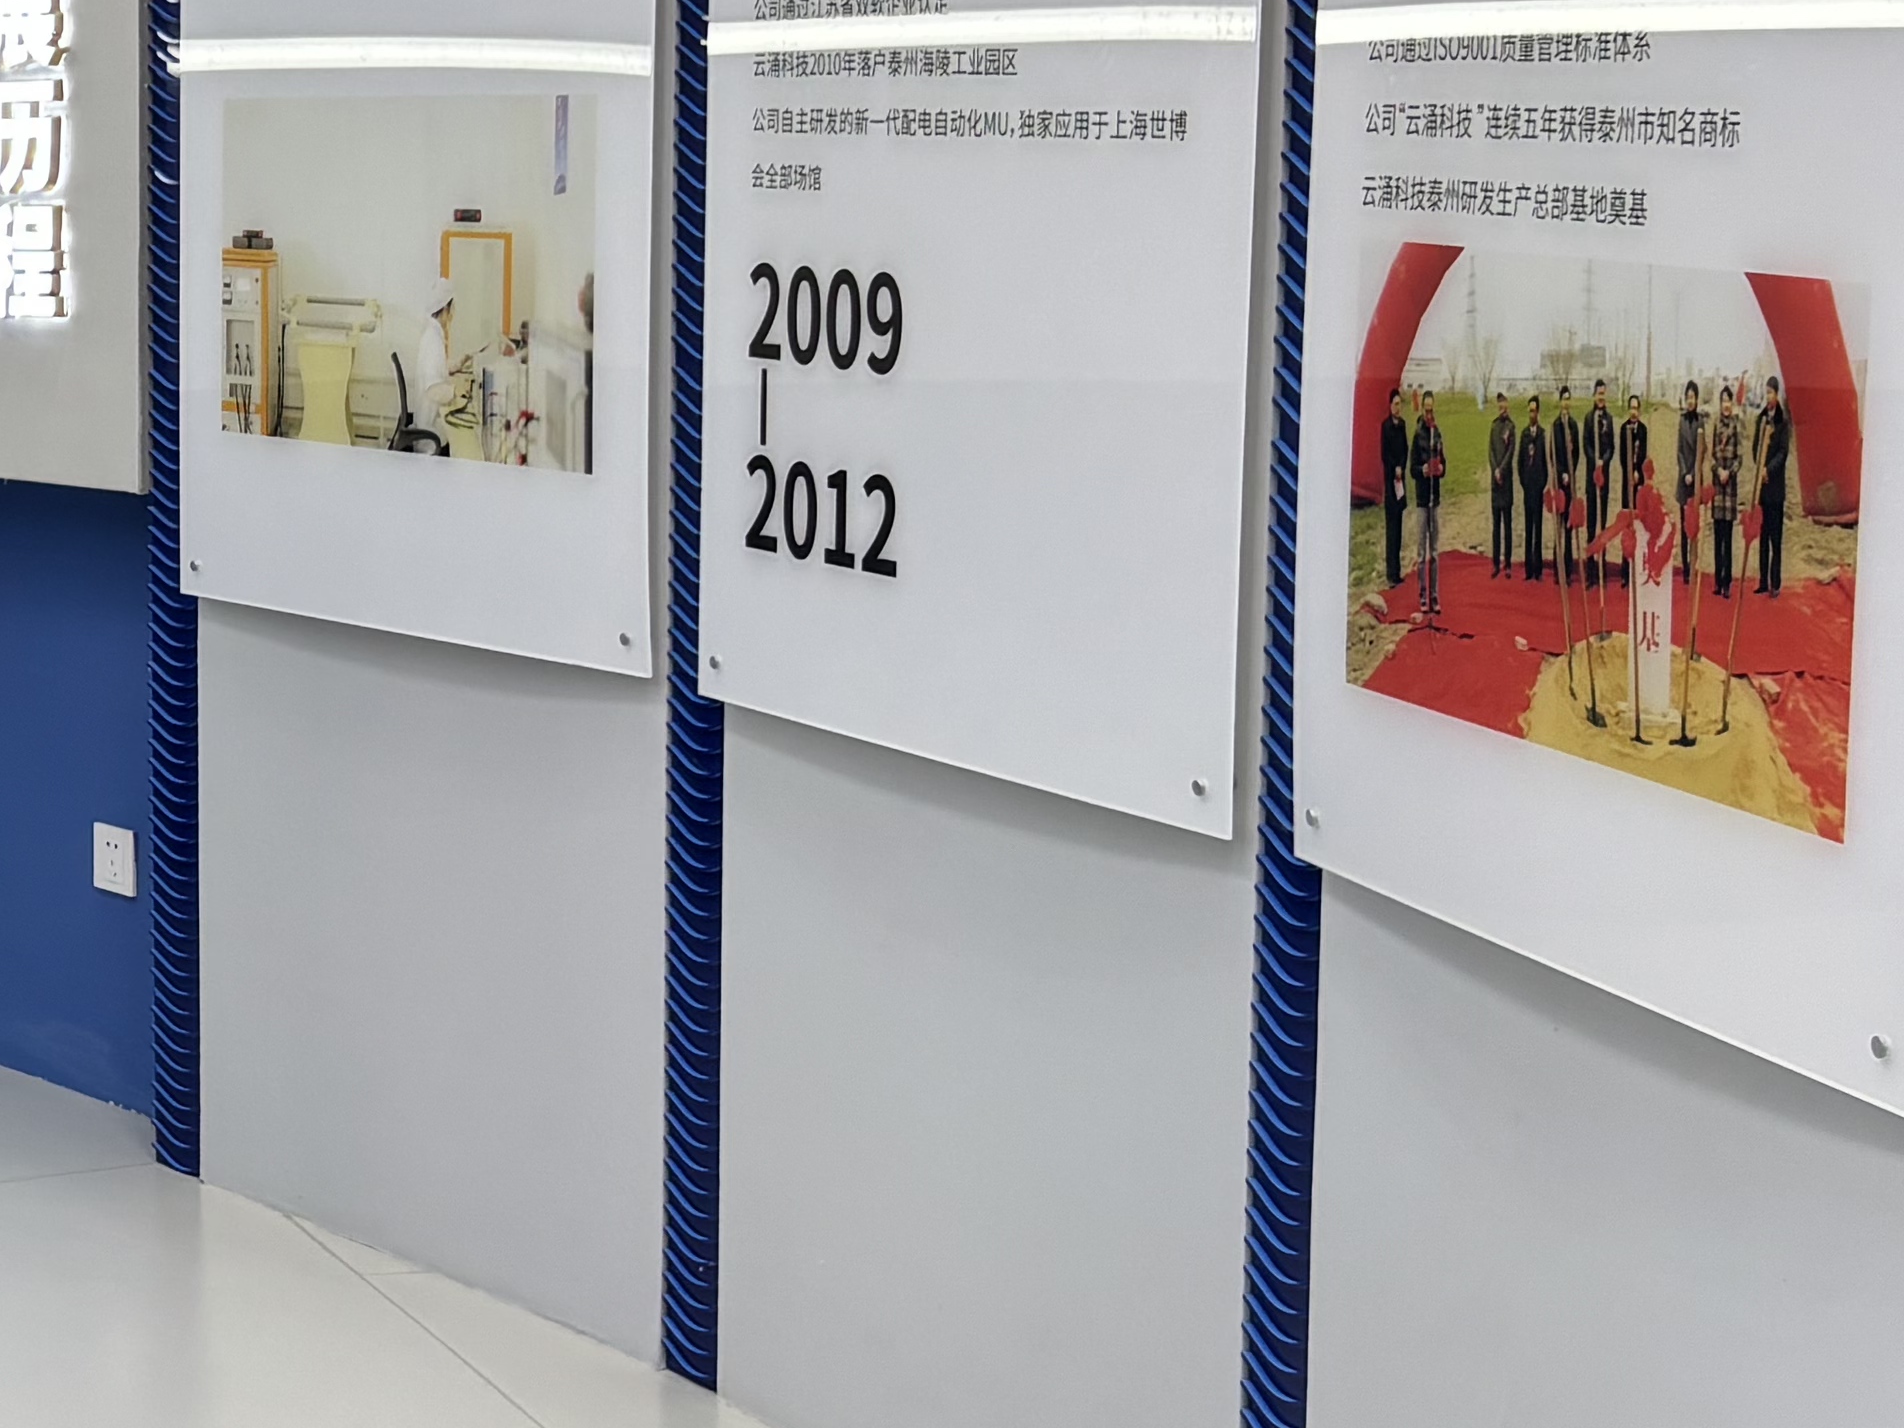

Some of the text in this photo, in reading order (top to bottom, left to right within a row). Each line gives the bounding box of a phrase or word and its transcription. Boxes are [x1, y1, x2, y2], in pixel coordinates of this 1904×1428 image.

[753, 48, 1019, 79] 云涌科技2010年落户泰州海陵工业园区
[1368, 30, 1652, 64] 公司通过ISO9001质量管理标准体系
[751, 164, 823, 192] 会全部场馆
[1361, 174, 1649, 228] 云涌科技泰州研发生产总部基地奠基
[749, 262, 903, 376] 2009
[745, 454, 898, 579] 2012
